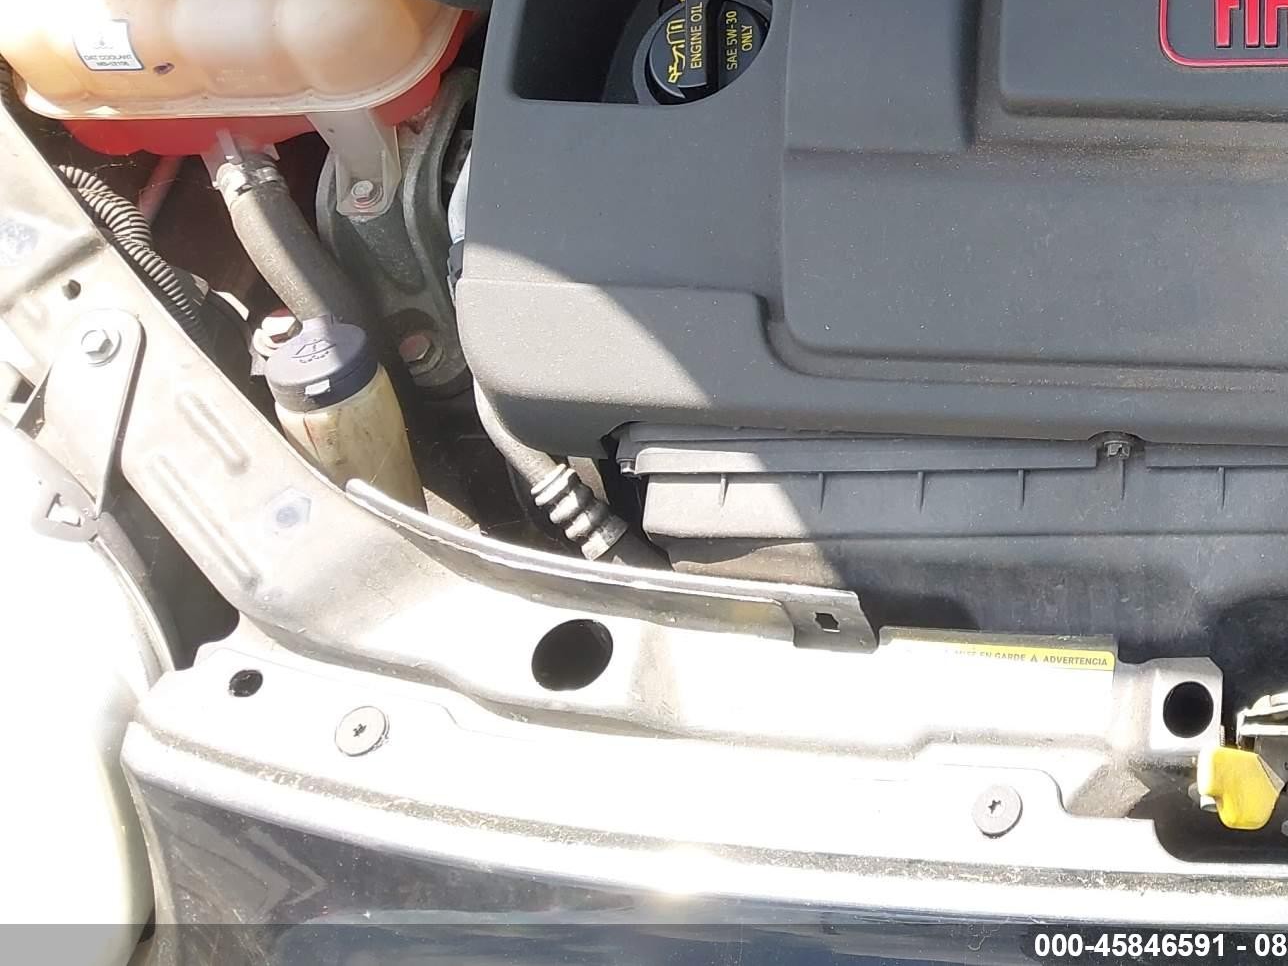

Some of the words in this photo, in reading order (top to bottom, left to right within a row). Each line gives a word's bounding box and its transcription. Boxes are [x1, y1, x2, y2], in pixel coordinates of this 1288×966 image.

[690, 1, 703, 23] OIL
[725, 10, 737, 45] 5W-30
[741, 24, 753, 52] ONLY
[690, 25, 702, 69] ENGINE
[726, 49, 738, 71] SAE
[1042, 654, 1109, 666] ADVERTENCIA
